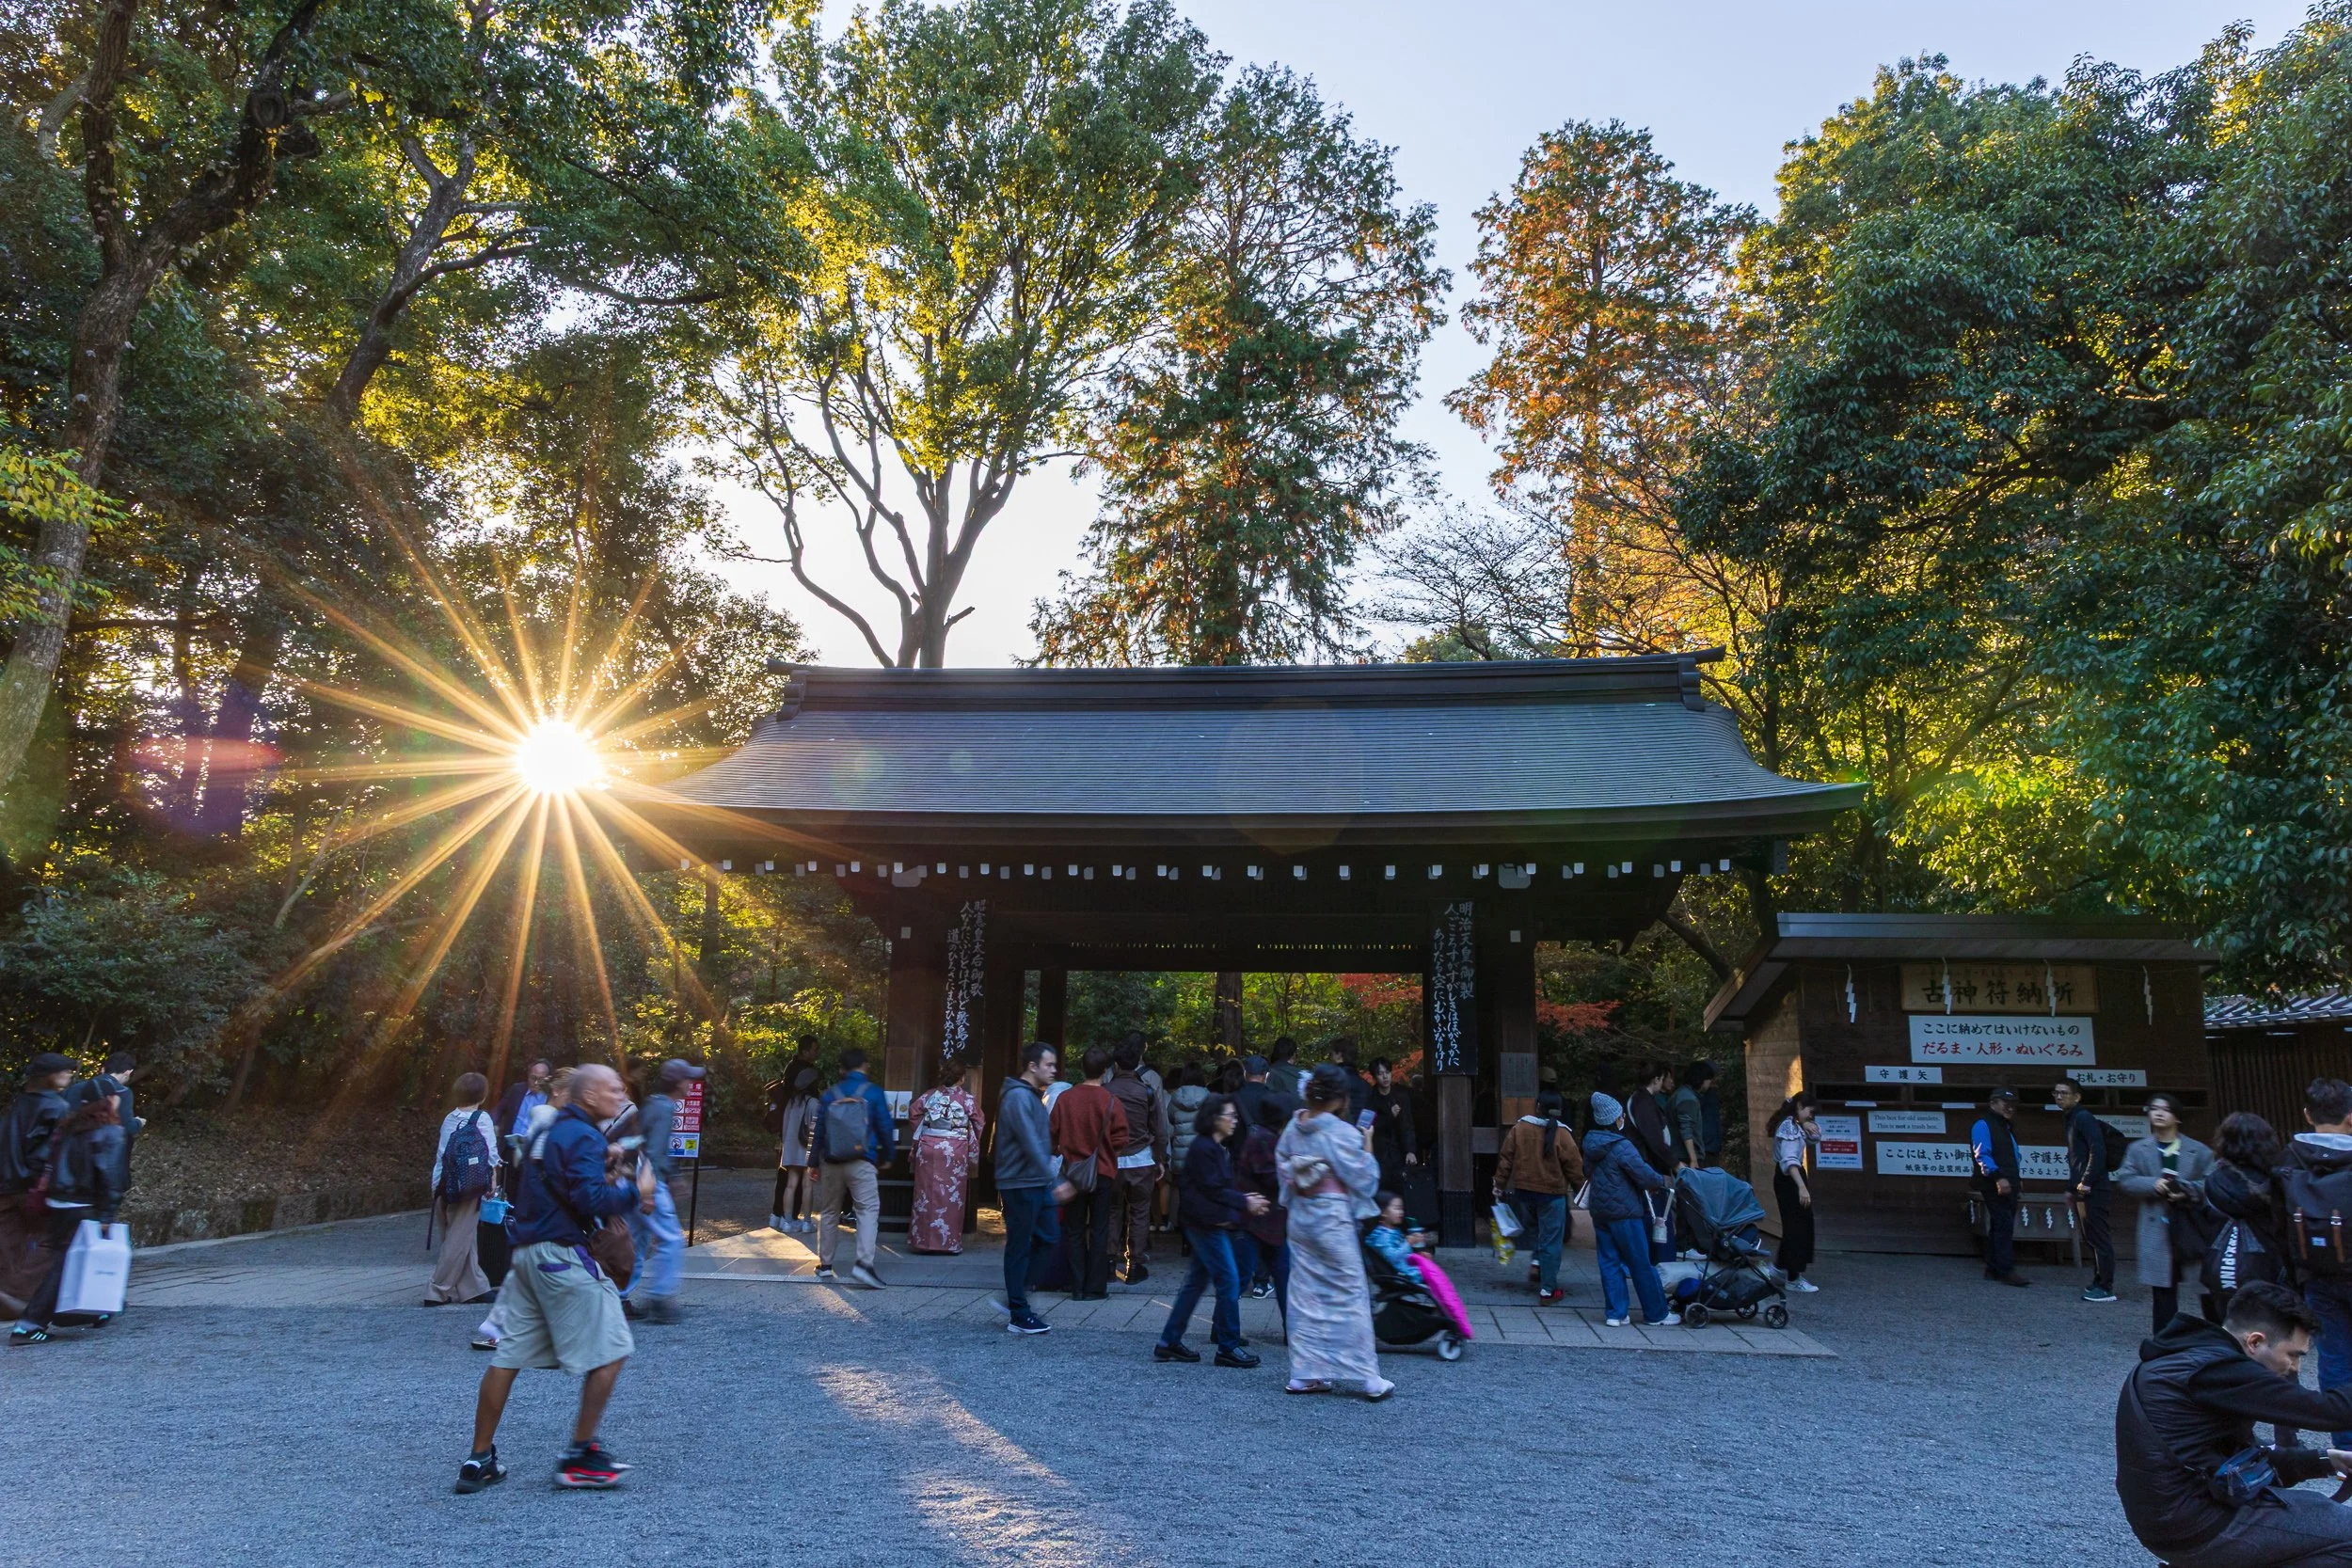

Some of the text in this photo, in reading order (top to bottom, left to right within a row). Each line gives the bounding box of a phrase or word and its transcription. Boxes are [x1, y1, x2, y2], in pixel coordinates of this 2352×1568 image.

[970, 899, 986, 996] 昭憲皇太后御歌
[1459, 901, 1474, 1000] 明治天皇御製
[1922, 979, 2074, 1006] 古神符納所
[1923, 1022, 2080, 1036] ここに納めてはいけないもの
[1922, 1042, 2084, 1057] だるま・人形・ぬいぐるみ
[1880, 1069, 1928, 1081] 守護矢
[2075, 1072, 2137, 1084] お札・お守り
[2220, 1258, 2237, 1289] PINK
